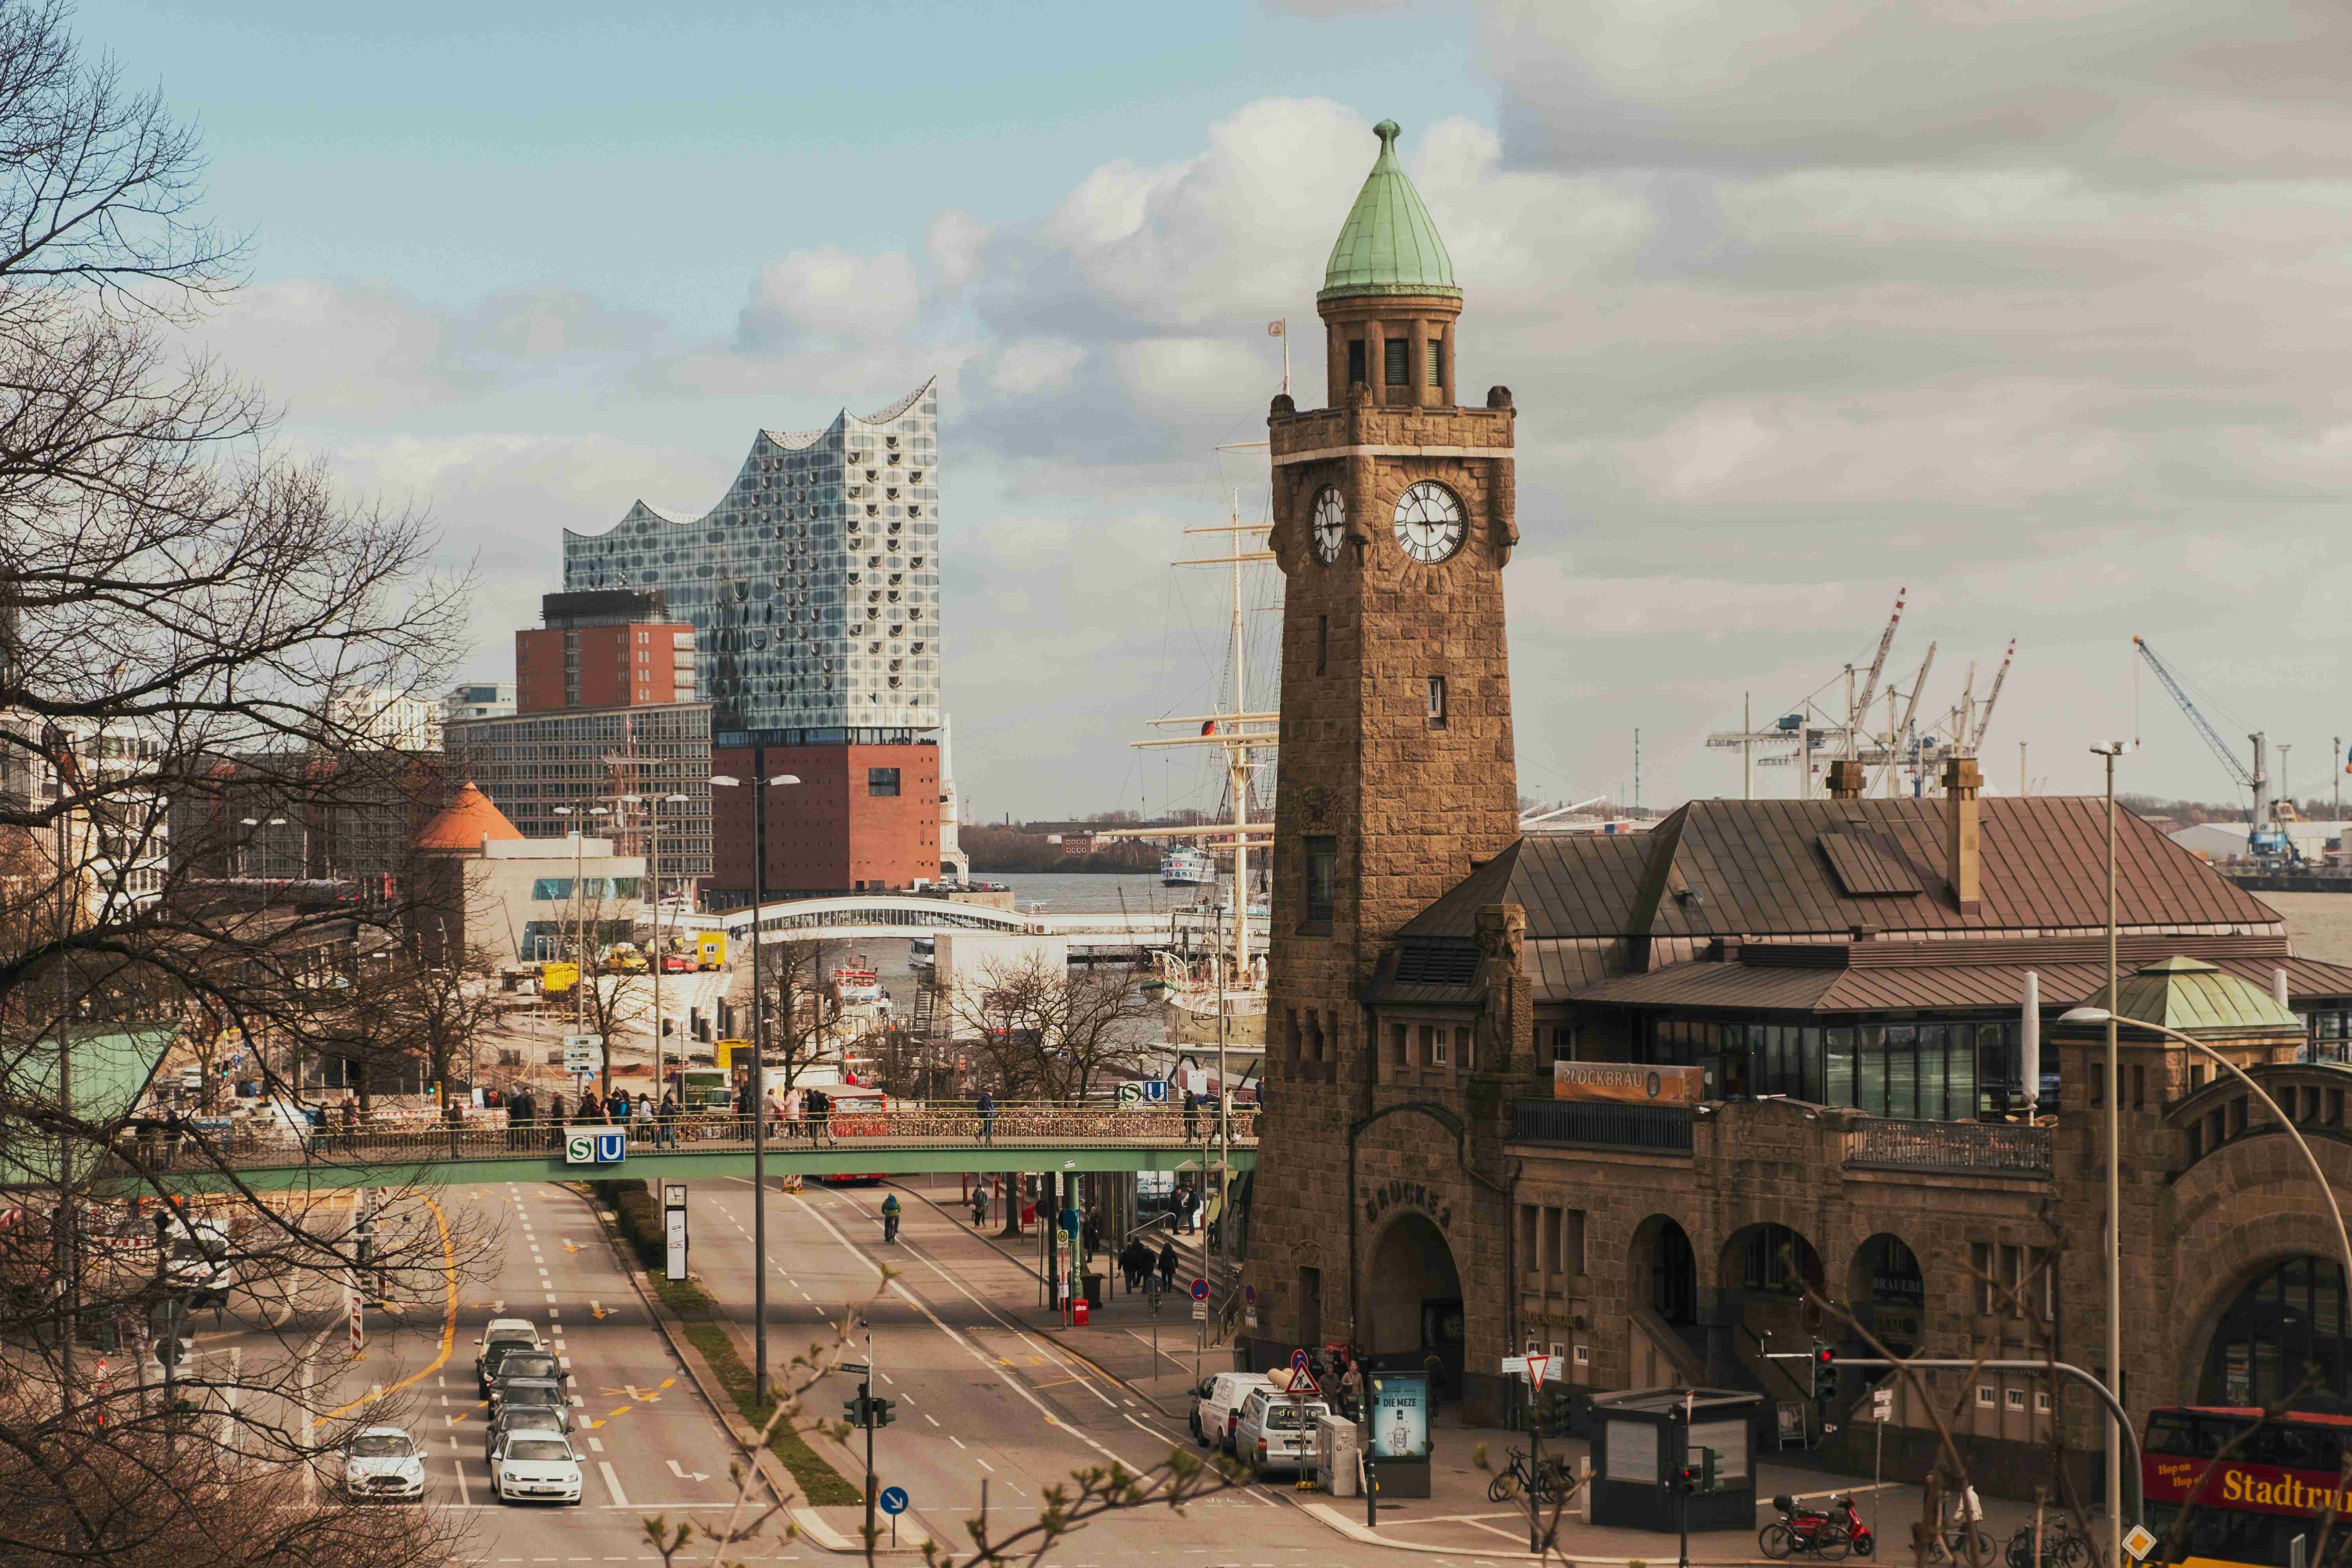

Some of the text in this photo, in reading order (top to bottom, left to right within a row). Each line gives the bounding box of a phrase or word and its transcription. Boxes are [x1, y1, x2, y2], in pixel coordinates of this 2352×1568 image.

[1564, 1069, 1644, 1088] BLOCKBRÄU
[1148, 1083, 1165, 1101] U
[569, 1138, 592, 1160] S
[602, 1137, 621, 1160] U
[1383, 1398, 1417, 1407] DIE MEZE
[2158, 1465, 2177, 1475] Hop
[2173, 1476, 2192, 1488] Hop
